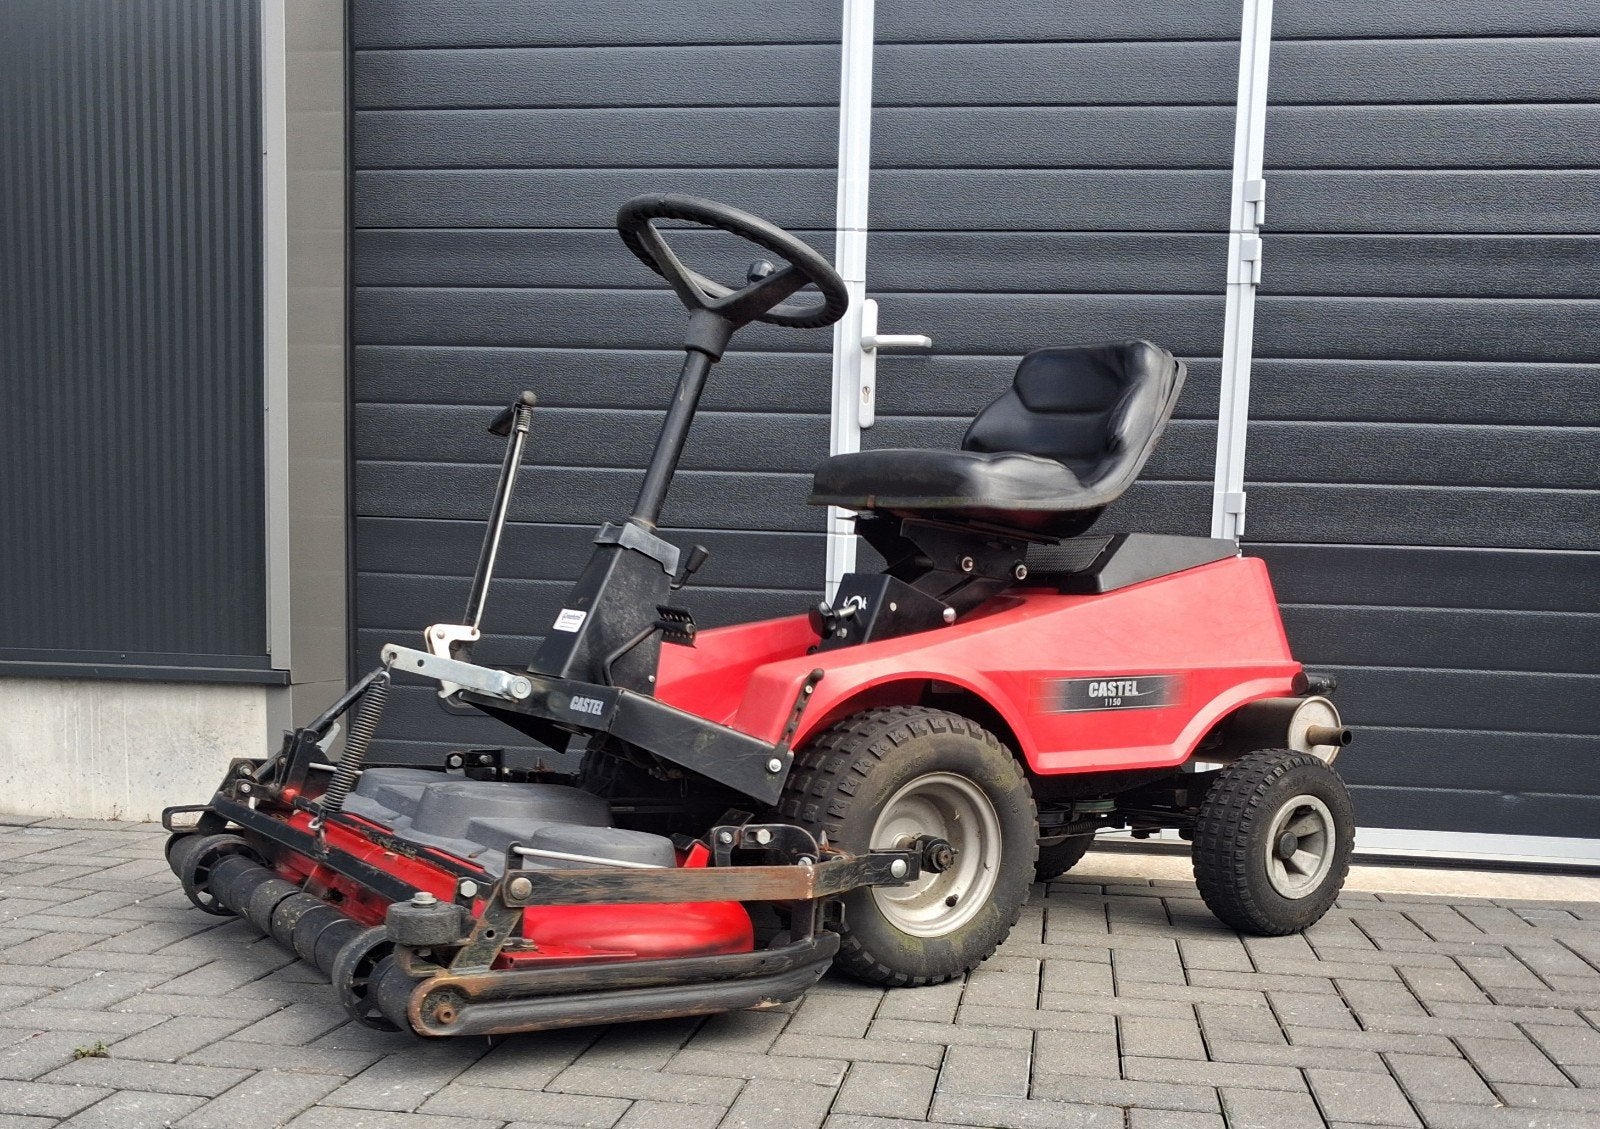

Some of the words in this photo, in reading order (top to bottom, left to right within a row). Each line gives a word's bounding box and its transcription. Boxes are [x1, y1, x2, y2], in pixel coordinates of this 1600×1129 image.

[1088, 681, 1139, 698] CASTEL
[570, 695, 604, 716] CASTEL
[1104, 698, 1122, 707] 1150
